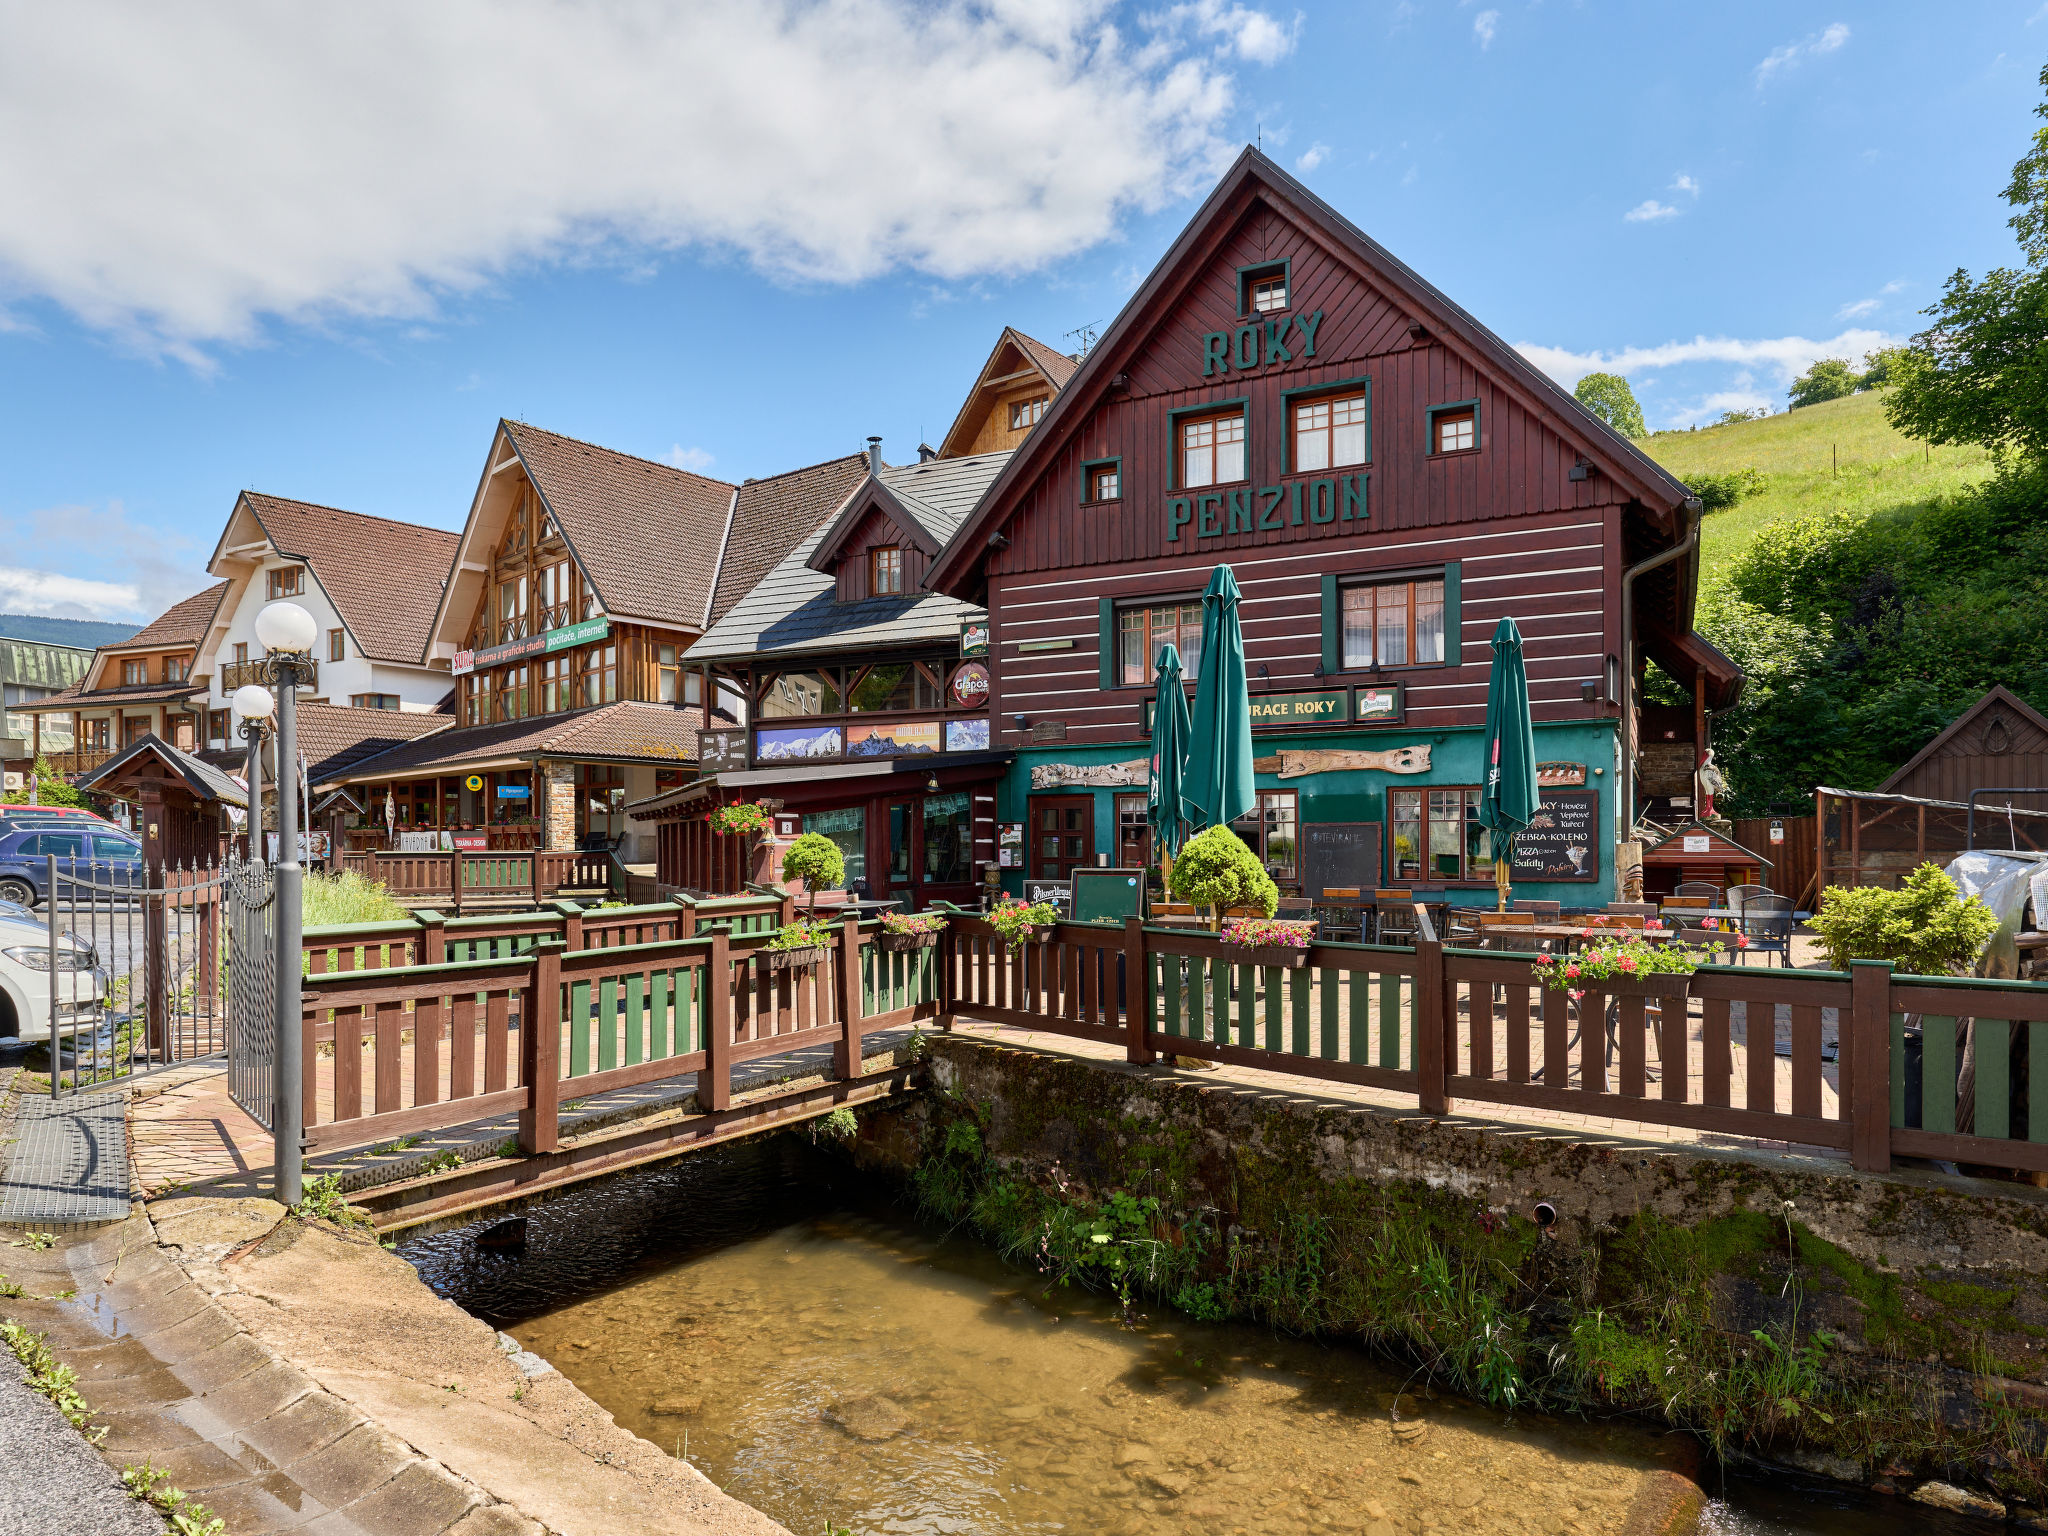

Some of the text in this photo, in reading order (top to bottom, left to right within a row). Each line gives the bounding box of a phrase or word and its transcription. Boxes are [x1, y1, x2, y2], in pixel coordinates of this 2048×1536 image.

[1203, 311, 1324, 377] ROKY
[1166, 473, 1370, 542] PENZION
[577, 622, 606, 640] internet
[475, 651, 497, 665] tiskárna
[502, 644, 525, 661] grafické
[526, 639, 546, 653] studio
[1248, 700, 1336, 718] RACE ROKY
[1033, 884, 1071, 904] Pilsner Urque
